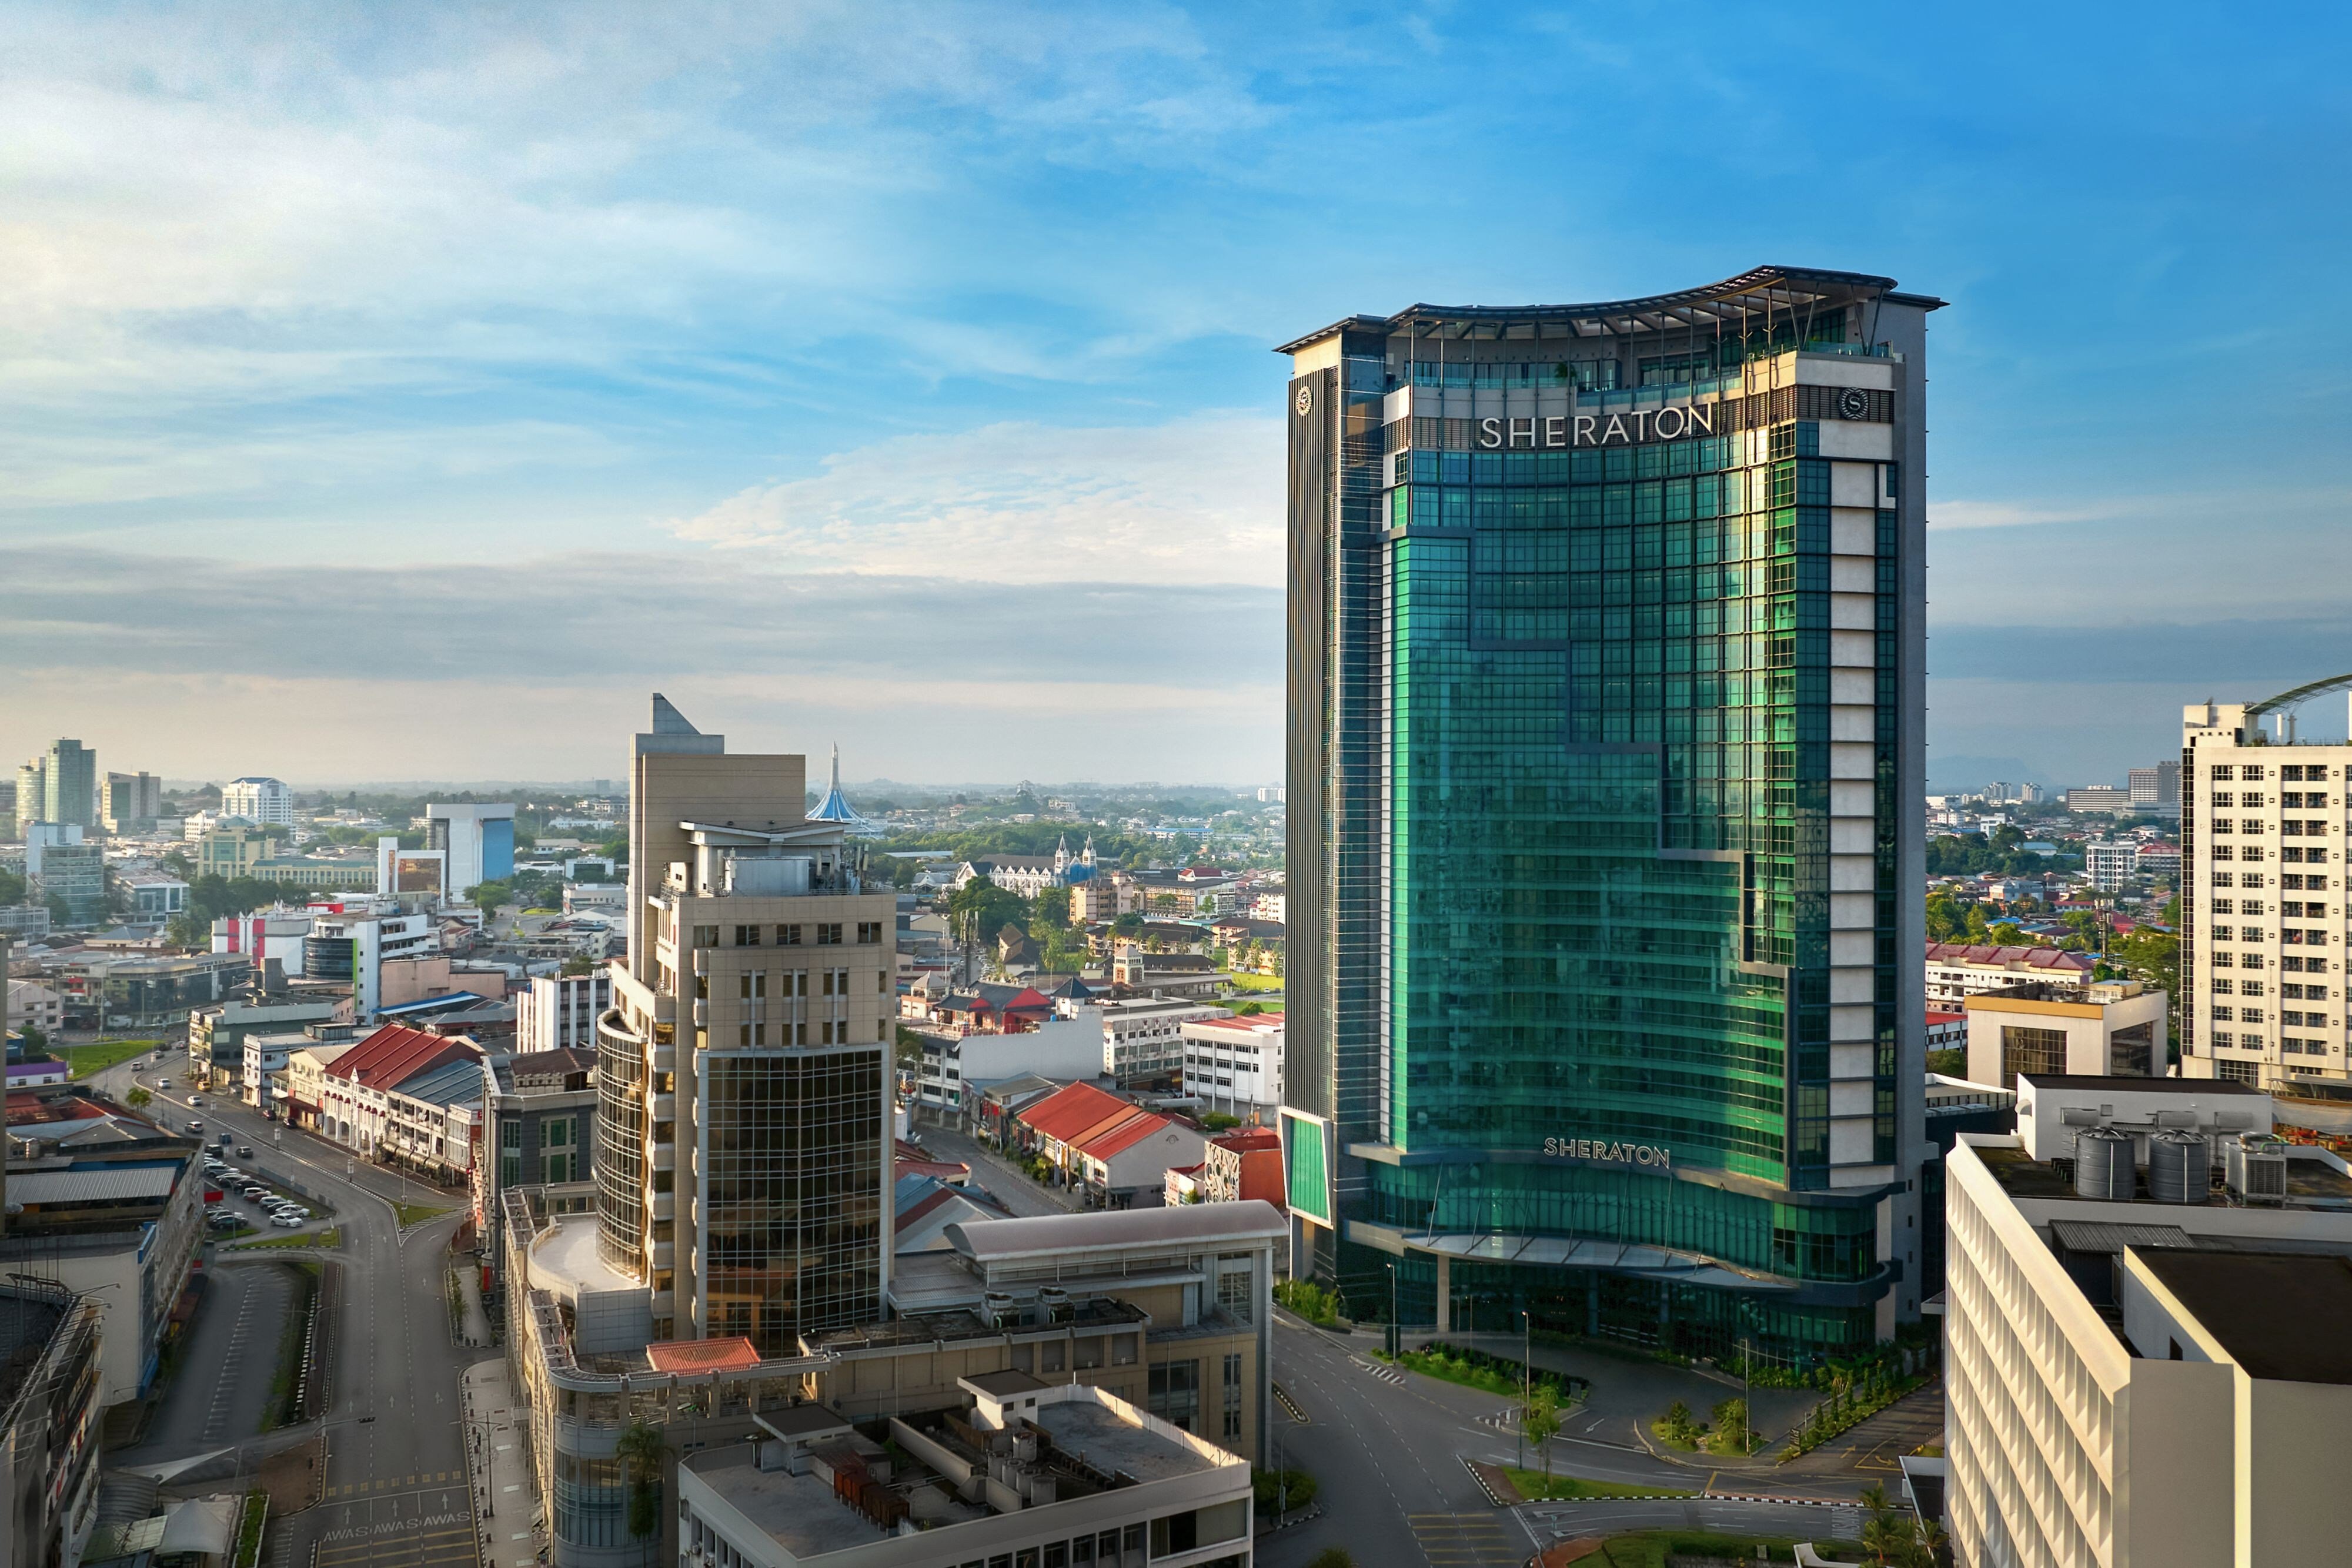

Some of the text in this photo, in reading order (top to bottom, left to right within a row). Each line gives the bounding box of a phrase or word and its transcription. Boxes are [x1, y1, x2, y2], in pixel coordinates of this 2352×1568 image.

[1849, 396, 1860, 410] S
[1480, 403, 1713, 447] SHERATON
[1544, 1138, 1669, 1169] SHERATON
[323, 1511, 470, 1542] AWAS AWAS AWAS
